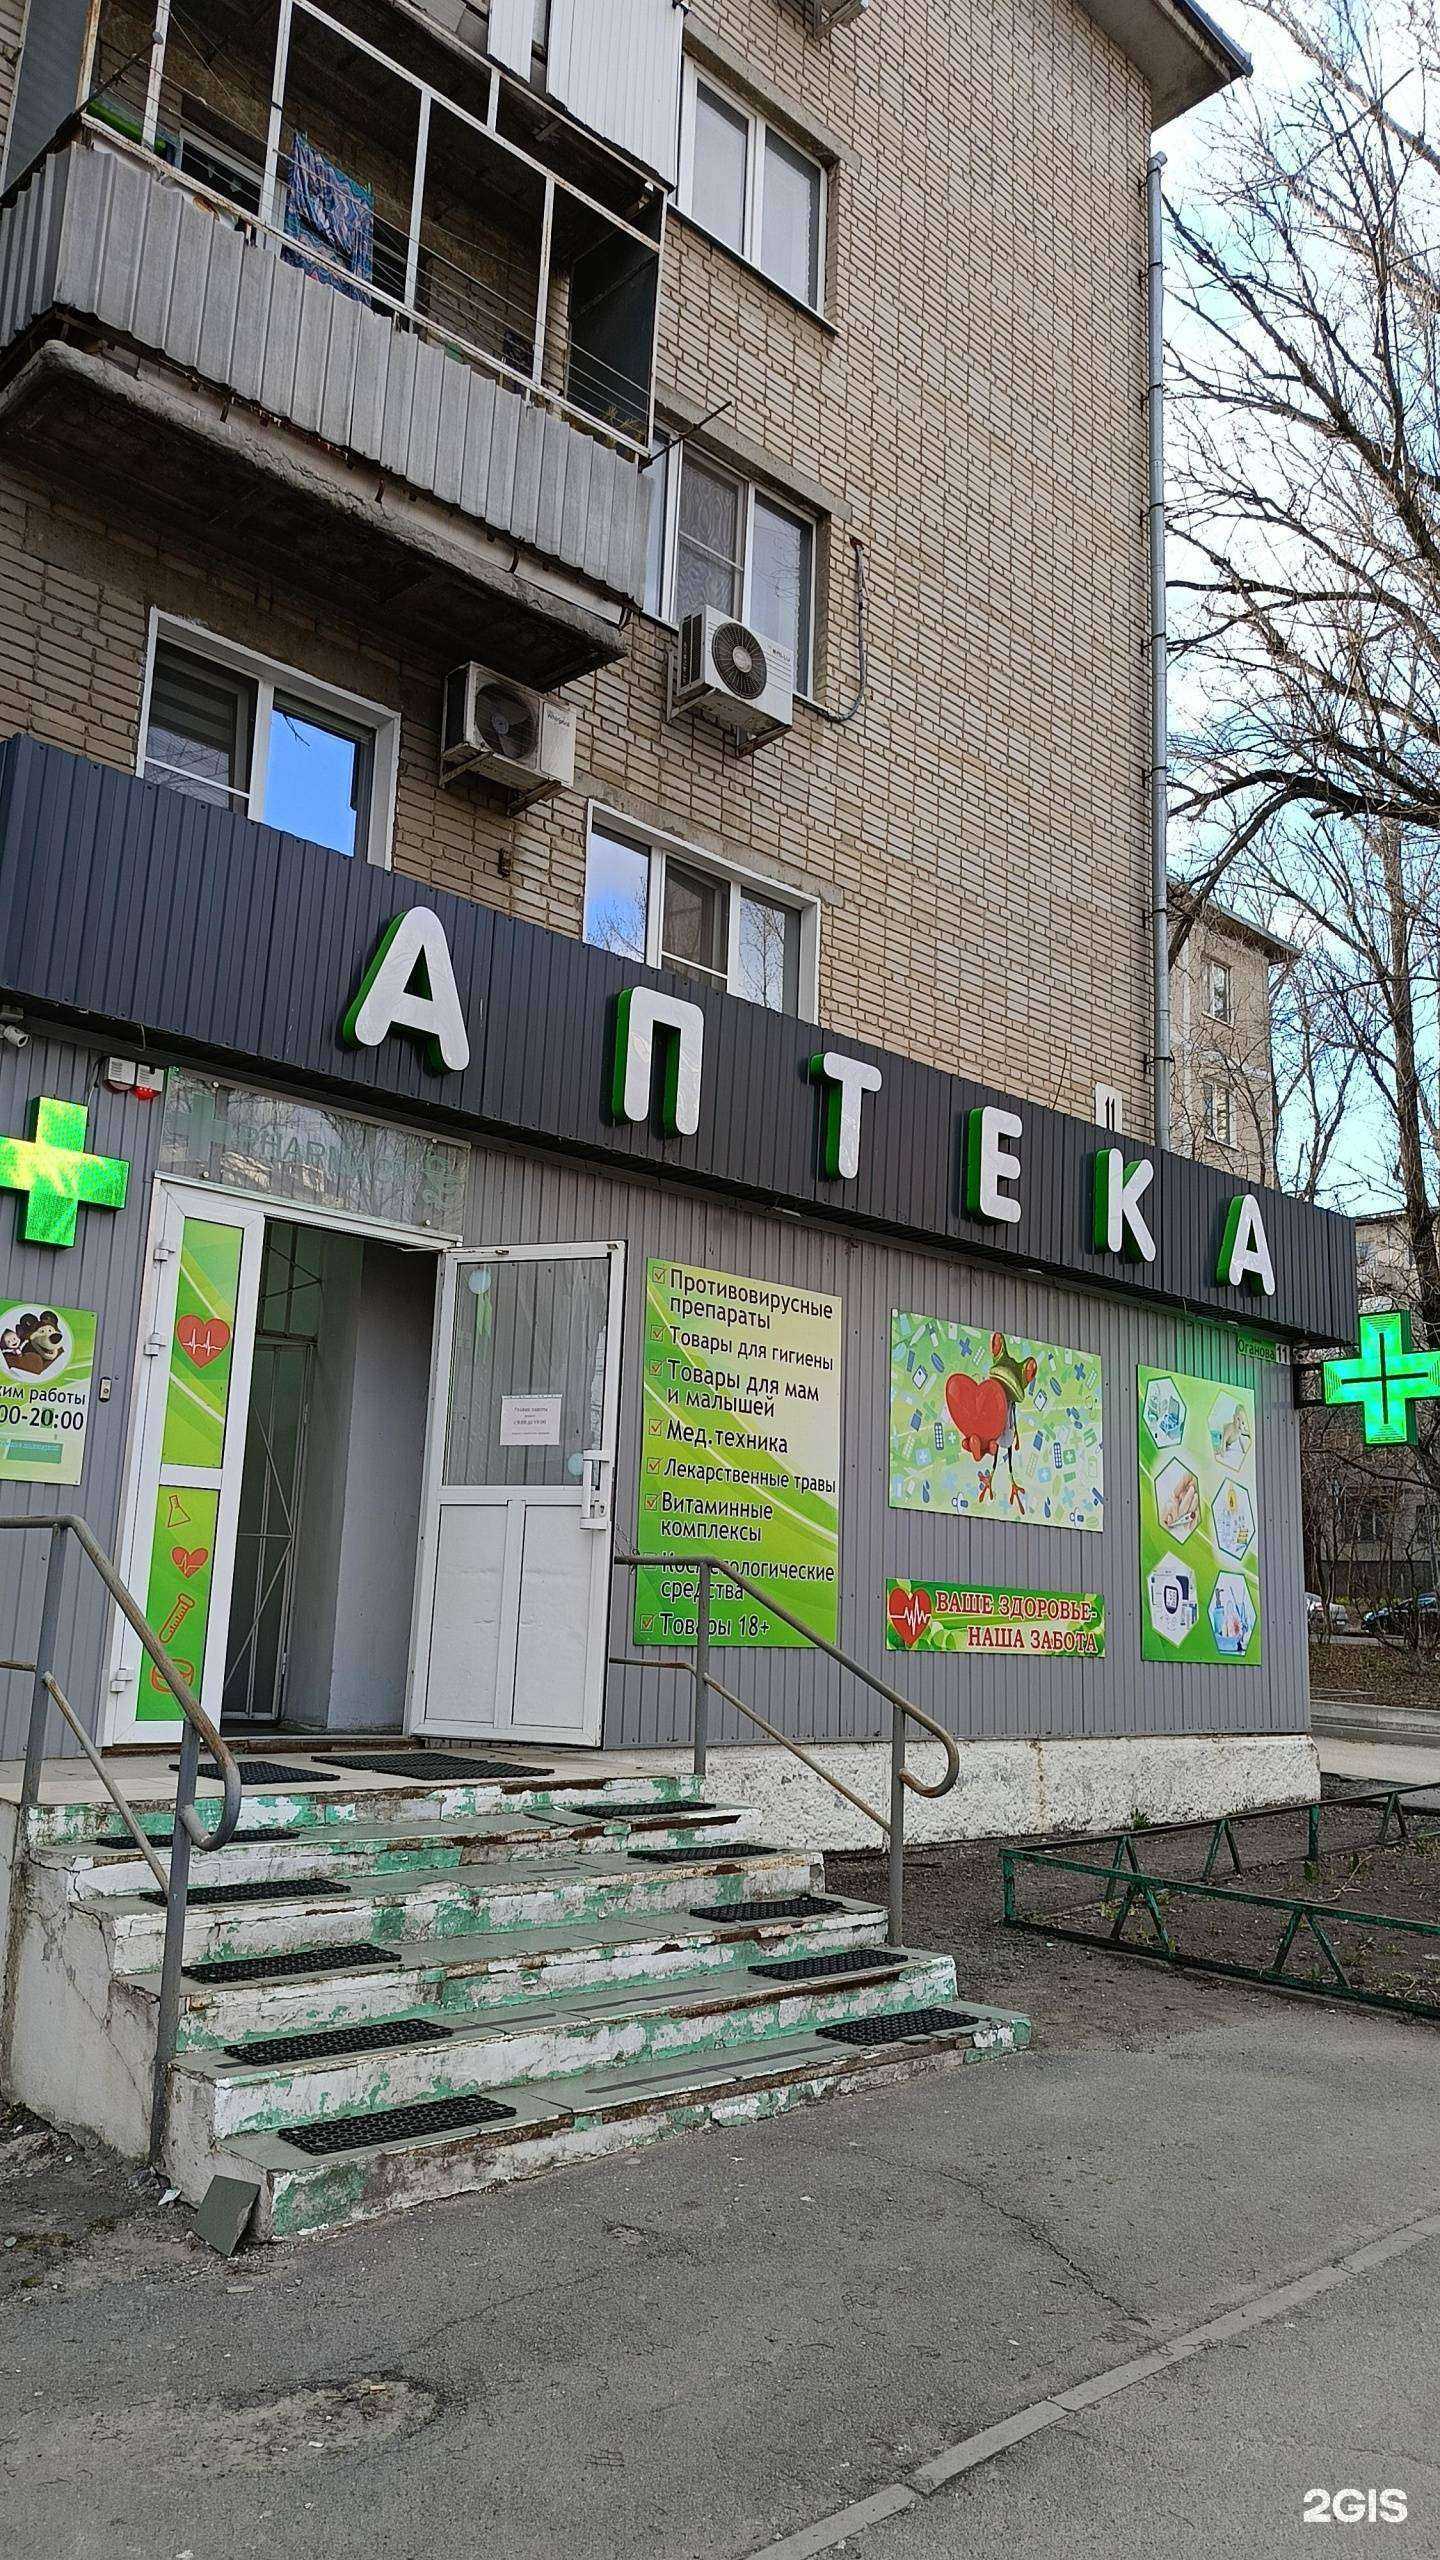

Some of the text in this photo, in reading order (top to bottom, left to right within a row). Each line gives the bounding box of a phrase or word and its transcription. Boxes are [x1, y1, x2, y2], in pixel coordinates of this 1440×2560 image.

[345, 906, 1276, 1296] АПТЕКА
[670, 1269, 833, 1319] Противовирусные
[670, 1297, 770, 1329] препараты
[670, 1326, 833, 1371] Товары для гигиены
[1277, 1344, 1287, 1363] 11
[668, 1359, 819, 1401] Товары для мам
[30, 1388, 85, 1405] работы
[668, 1389, 775, 1417] и малышей
[664, 1458, 836, 1493] Лекарственные травы
[662, 1491, 773, 1519] Витаминные
[661, 1521, 761, 1541] комплексы
[662, 1552, 835, 1581] Косеологические
[936, 1591, 993, 1614] ВАШЕ
[660, 1613, 770, 1637] Товры 18+
[967, 1626, 1098, 1652] НАША ЗАБОТА
